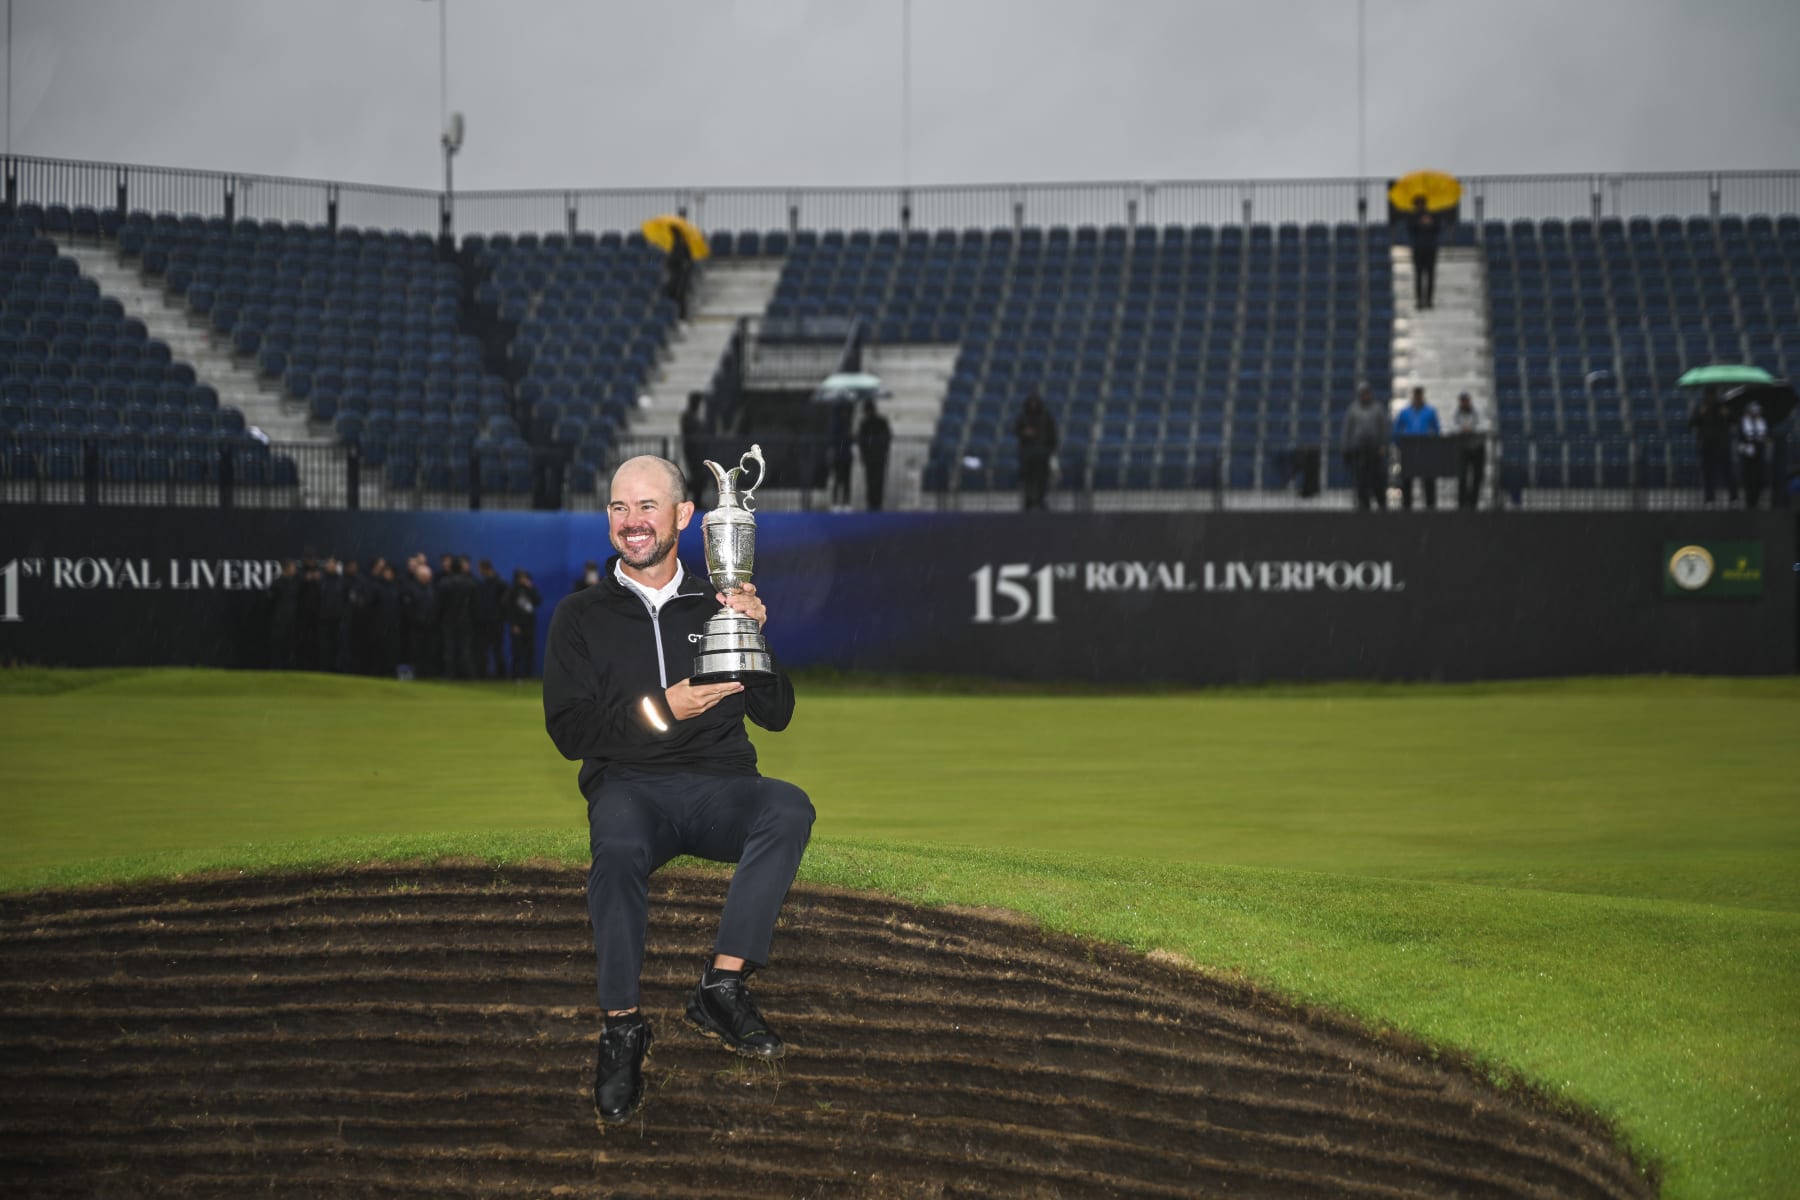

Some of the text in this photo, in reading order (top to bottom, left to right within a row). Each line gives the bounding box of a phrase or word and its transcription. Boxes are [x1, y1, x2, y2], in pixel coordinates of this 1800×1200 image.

[53, 556, 162, 589] ROYAL
[169, 557, 345, 591] LIVERP
[1084, 560, 1197, 591] ROYAL
[1203, 560, 1406, 592] LIVERPOOL
